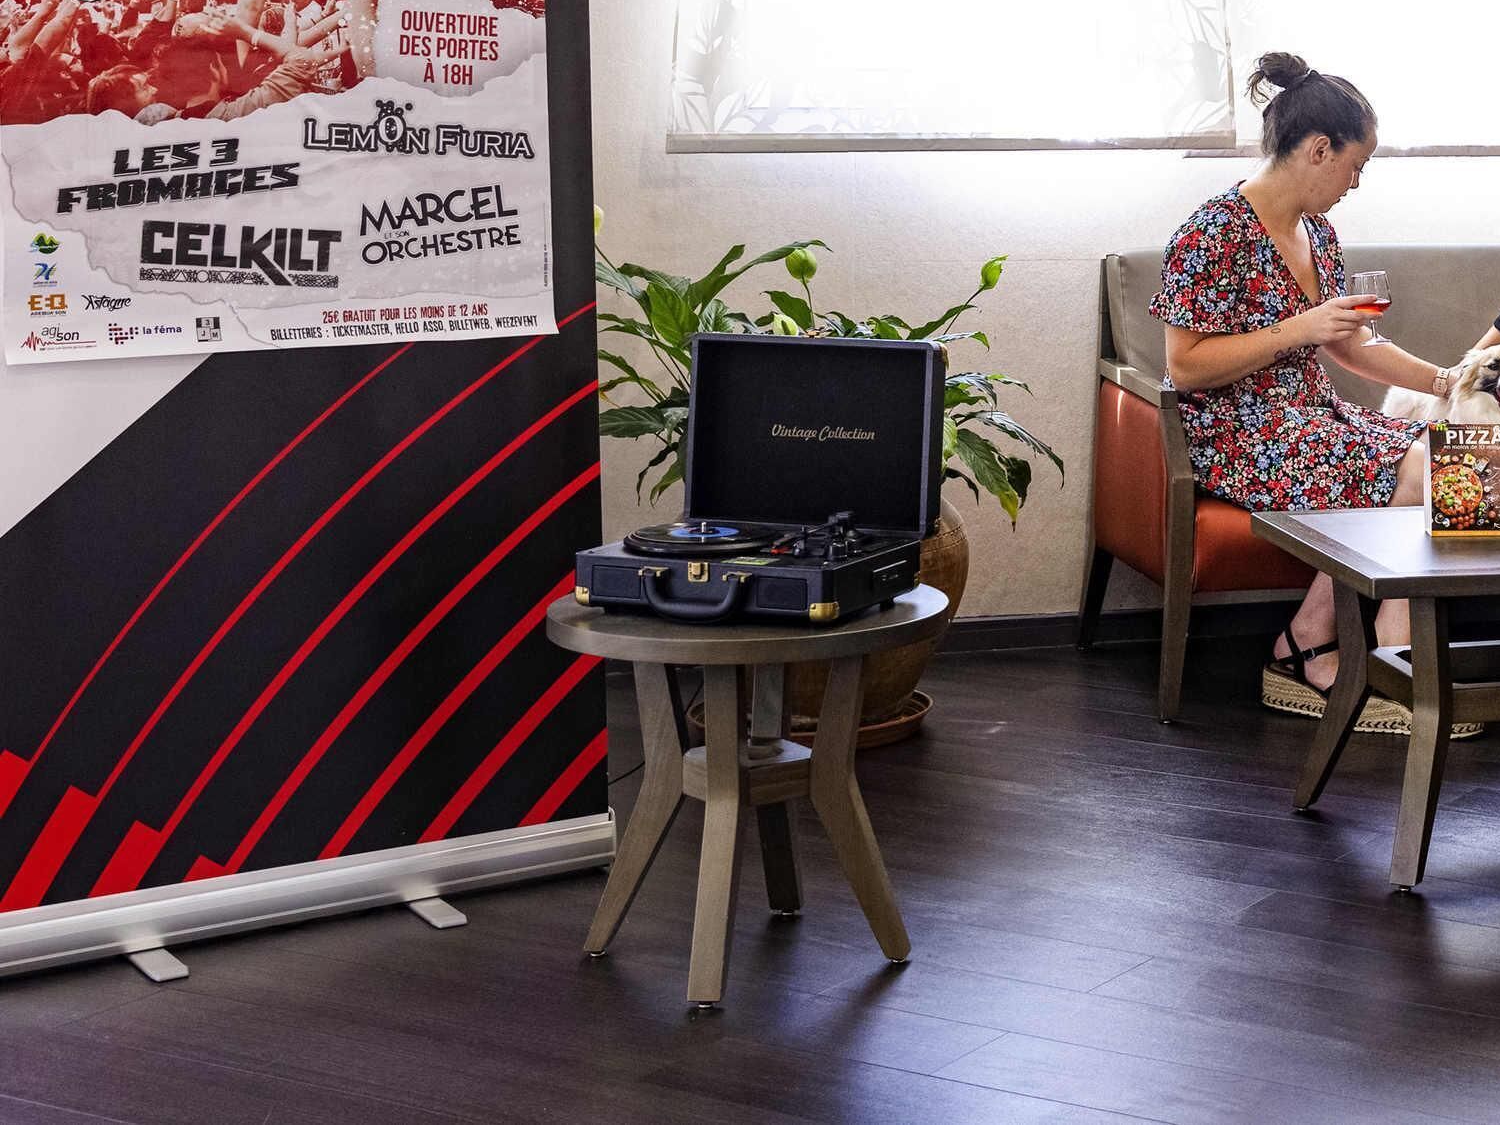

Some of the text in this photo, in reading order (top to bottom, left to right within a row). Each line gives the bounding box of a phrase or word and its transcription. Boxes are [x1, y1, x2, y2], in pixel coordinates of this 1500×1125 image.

[401, 9, 498, 37] OUVERTURE
[399, 34, 499, 62] DES PORTES
[423, 62, 473, 86] À 18H
[303, 115, 535, 159] LEMON FURIA
[114, 138, 240, 177] LES 3
[56, 162, 300, 214] FROMAGES
[360, 185, 518, 236] MARCEL
[140, 220, 342, 287] CELKILT
[361, 224, 521, 264] ORCHESTRE
[323, 303, 488, 324] 25€ GRATUIT POUR LES MOINS DE 12 ANS
[56, 331, 80, 341] son
[142, 325, 182, 335] la féma
[270, 327, 322, 341] BILLETTERIES
[332, 322, 393, 338] TICKETMASTER,
[396, 321, 419, 334] HELLO
[771, 424, 876, 442] Vintage Collection
